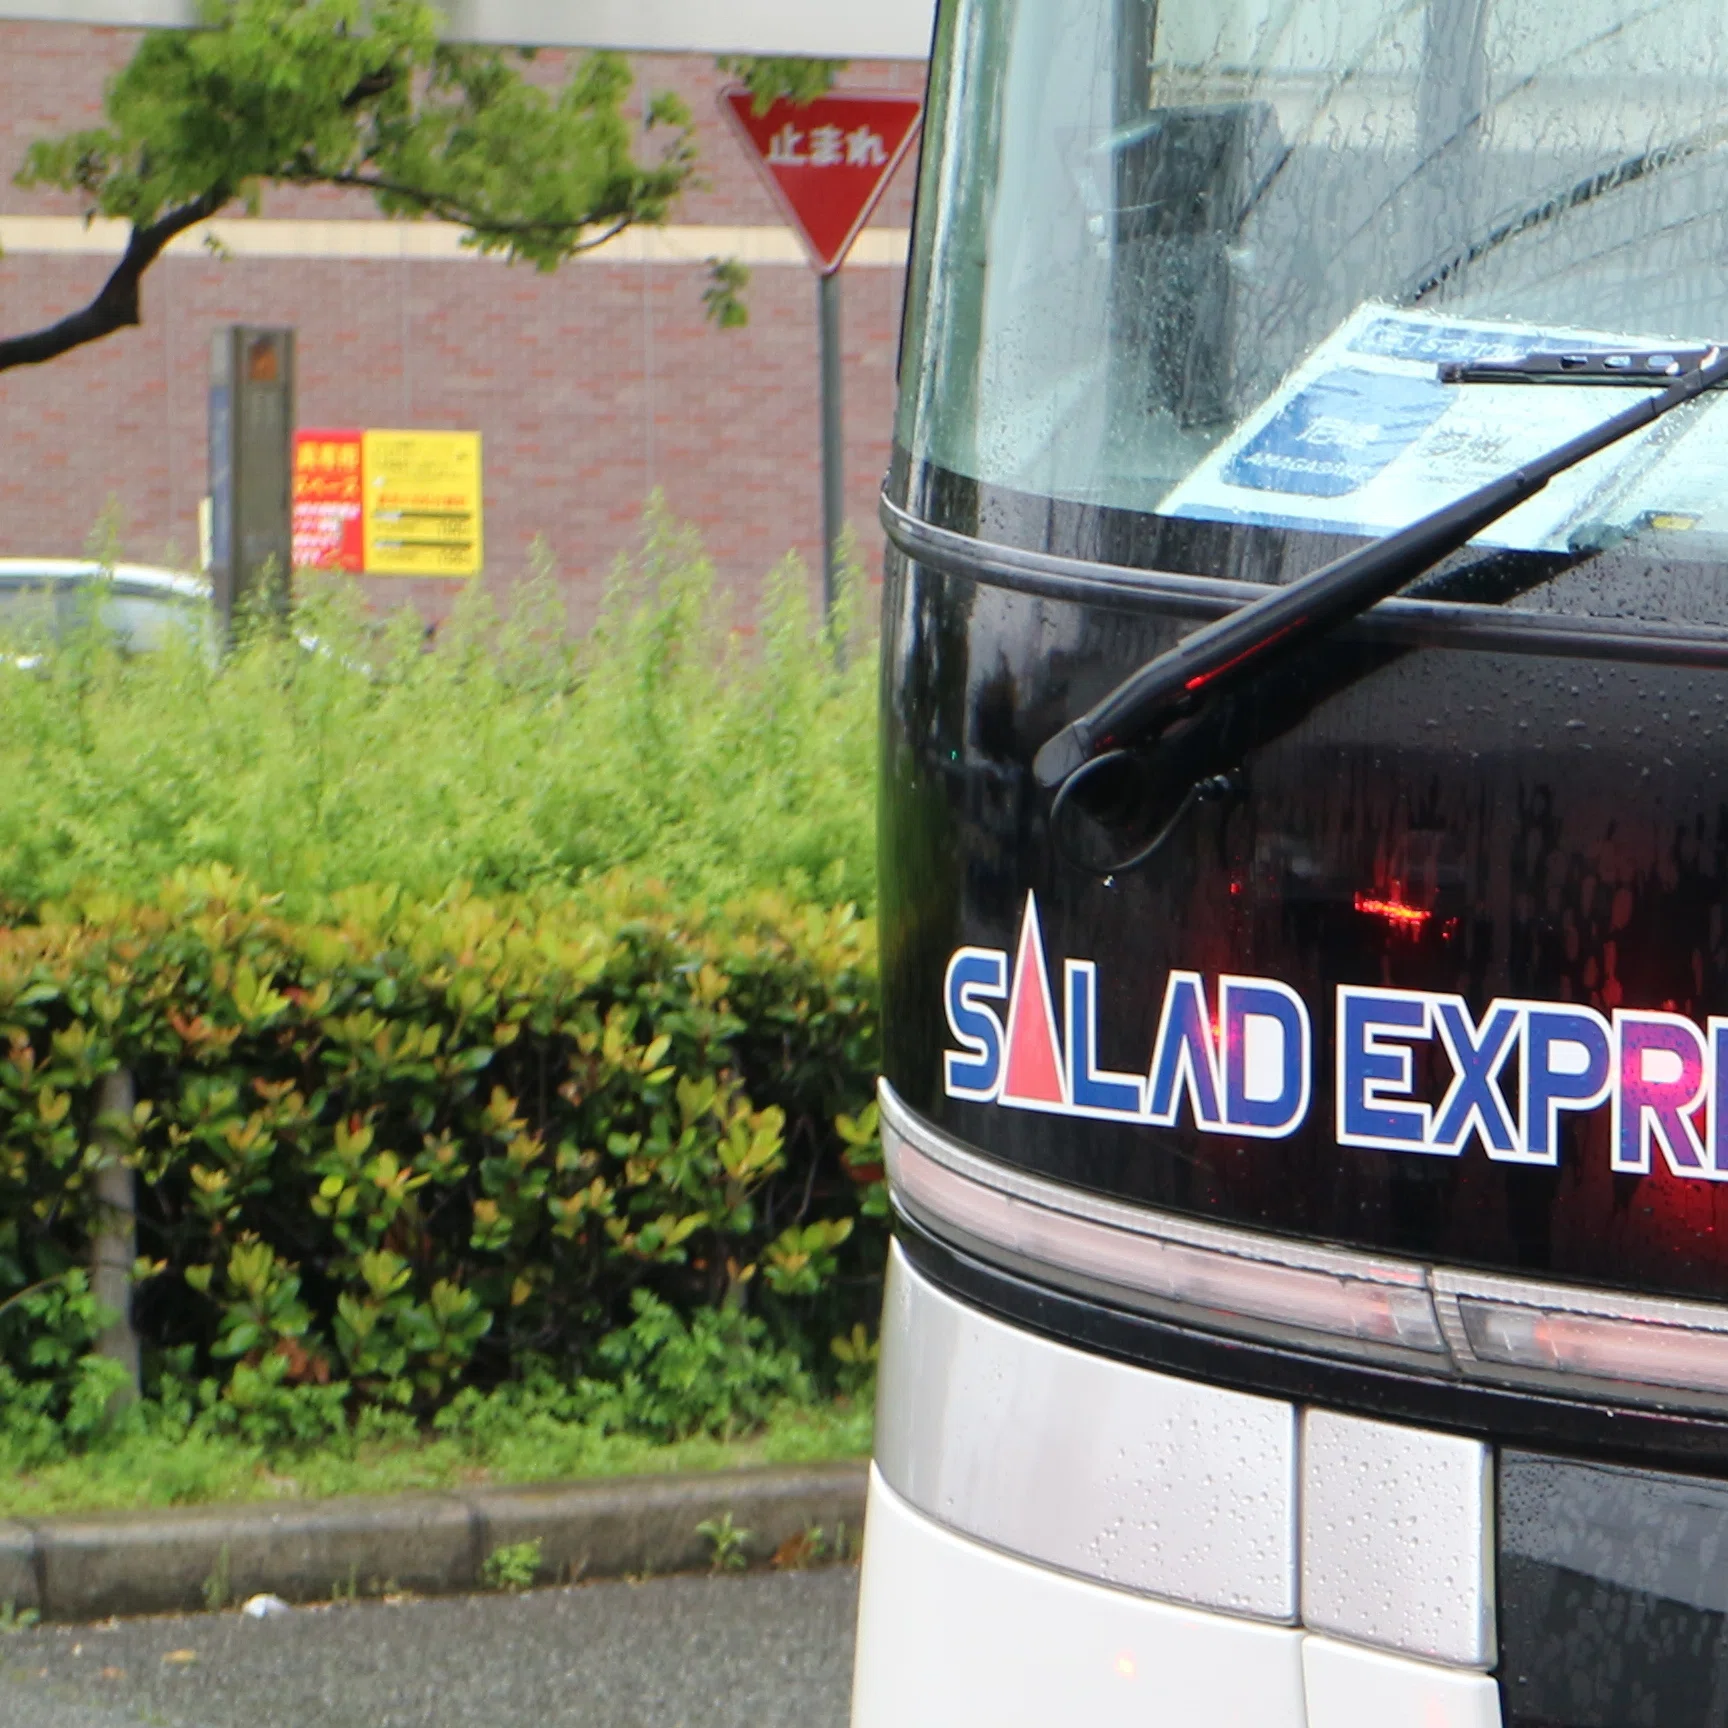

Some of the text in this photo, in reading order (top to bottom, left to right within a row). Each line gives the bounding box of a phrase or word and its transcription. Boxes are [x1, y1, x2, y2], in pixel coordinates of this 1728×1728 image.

[767, 121, 889, 166] 止まれ
[944, 888, 1311, 1139] SALAD
